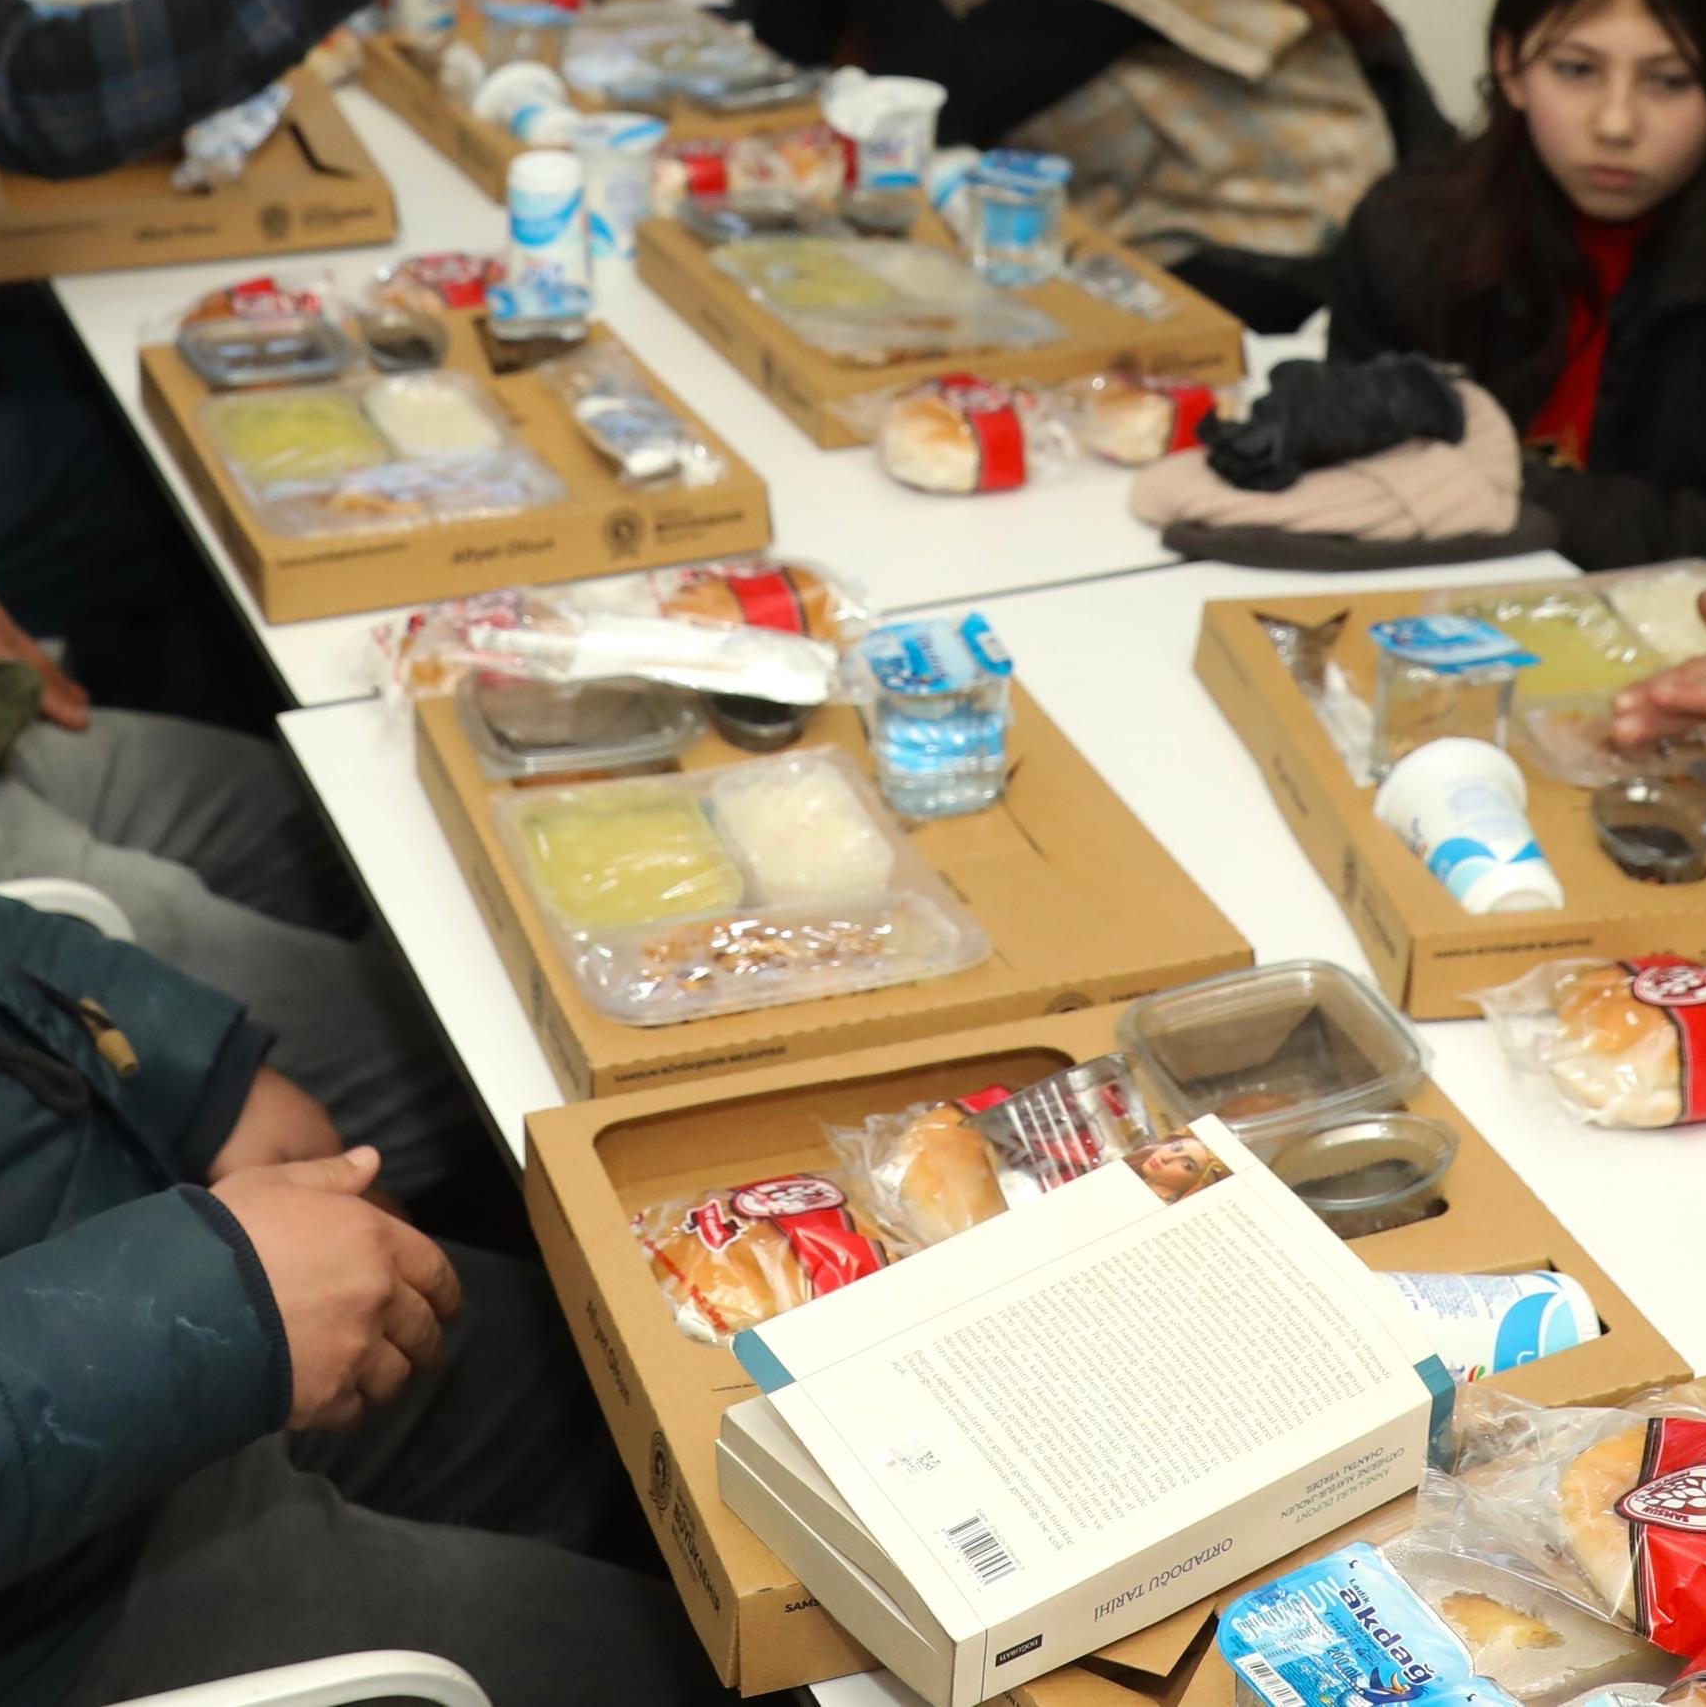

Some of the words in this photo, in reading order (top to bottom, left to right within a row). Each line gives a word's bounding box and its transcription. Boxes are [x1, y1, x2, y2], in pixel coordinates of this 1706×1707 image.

[1148, 1538, 1234, 1592] ORTADOĞU
[1094, 1583, 1145, 1622] TARİHİ
[1349, 1578, 1371, 1604] Ladik
[1339, 1587, 1435, 1686] akdağ
